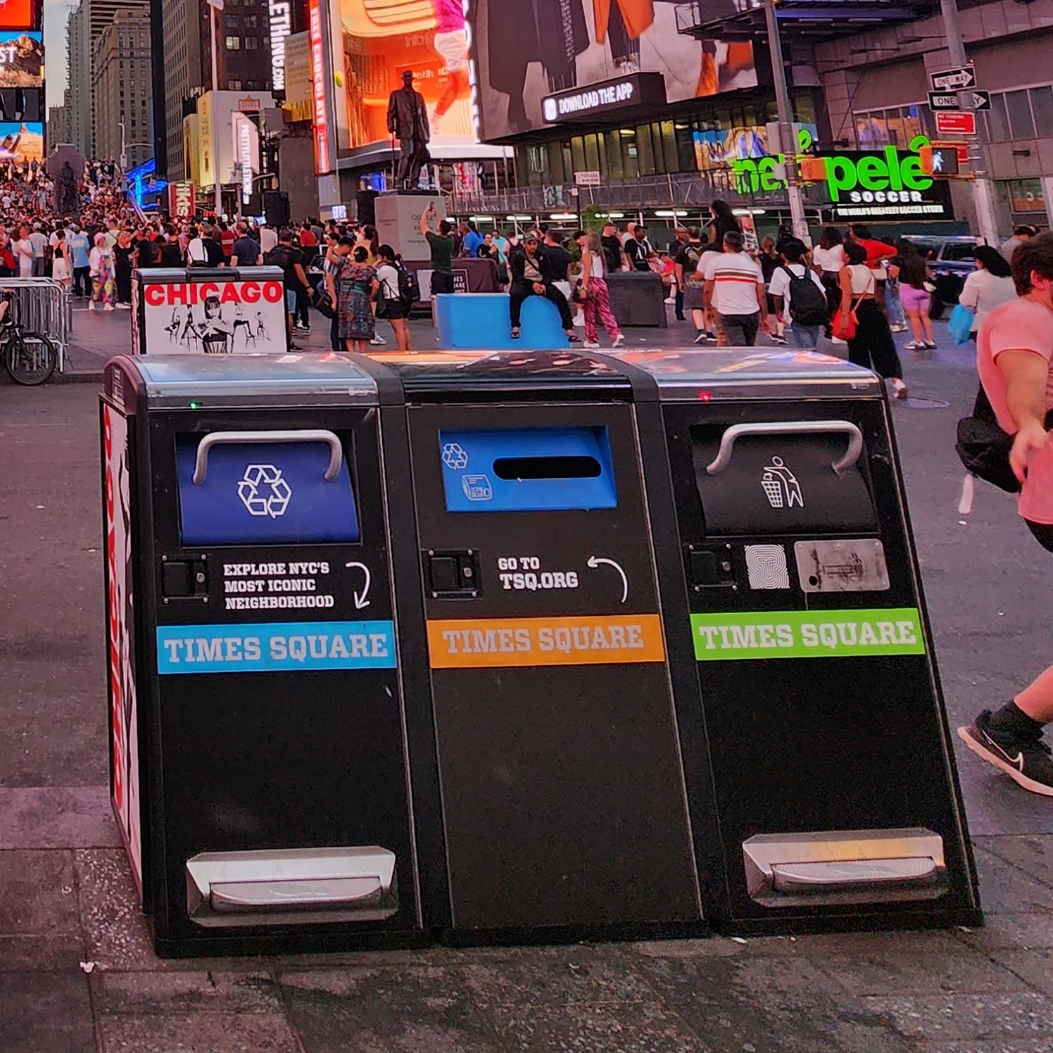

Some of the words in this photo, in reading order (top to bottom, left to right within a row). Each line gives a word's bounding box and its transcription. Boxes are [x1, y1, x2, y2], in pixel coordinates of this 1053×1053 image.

[956, 74, 968, 83] WAY
[558, 90, 599, 114] DOWNLOAD
[597, 86, 616, 105] THE
[616, 82, 633, 101] APP
[937, 97, 956, 105] ONE
[850, 191, 923, 203] SOCCER
[144, 281, 283, 306] CHICAGO
[223, 563, 286, 576] EXPLORE
[289, 562, 330, 575] NYC'S
[498, 557, 518, 571] GO
[520, 557, 540, 570] TO
[224, 580, 265, 593] MOST
[267, 579, 316, 592] ICONIC
[499, 571, 579, 590] TSQ.ORG
[225, 595, 334, 610] NEIGHBORHOOD
[442, 627, 531, 655] TIMES
[538, 624, 644, 653] SQUARE
[699, 623, 795, 650] TIMES
[801, 620, 917, 648] SQUARE
[164, 636, 262, 663] TIMES
[269, 634, 389, 662] SQUARE
